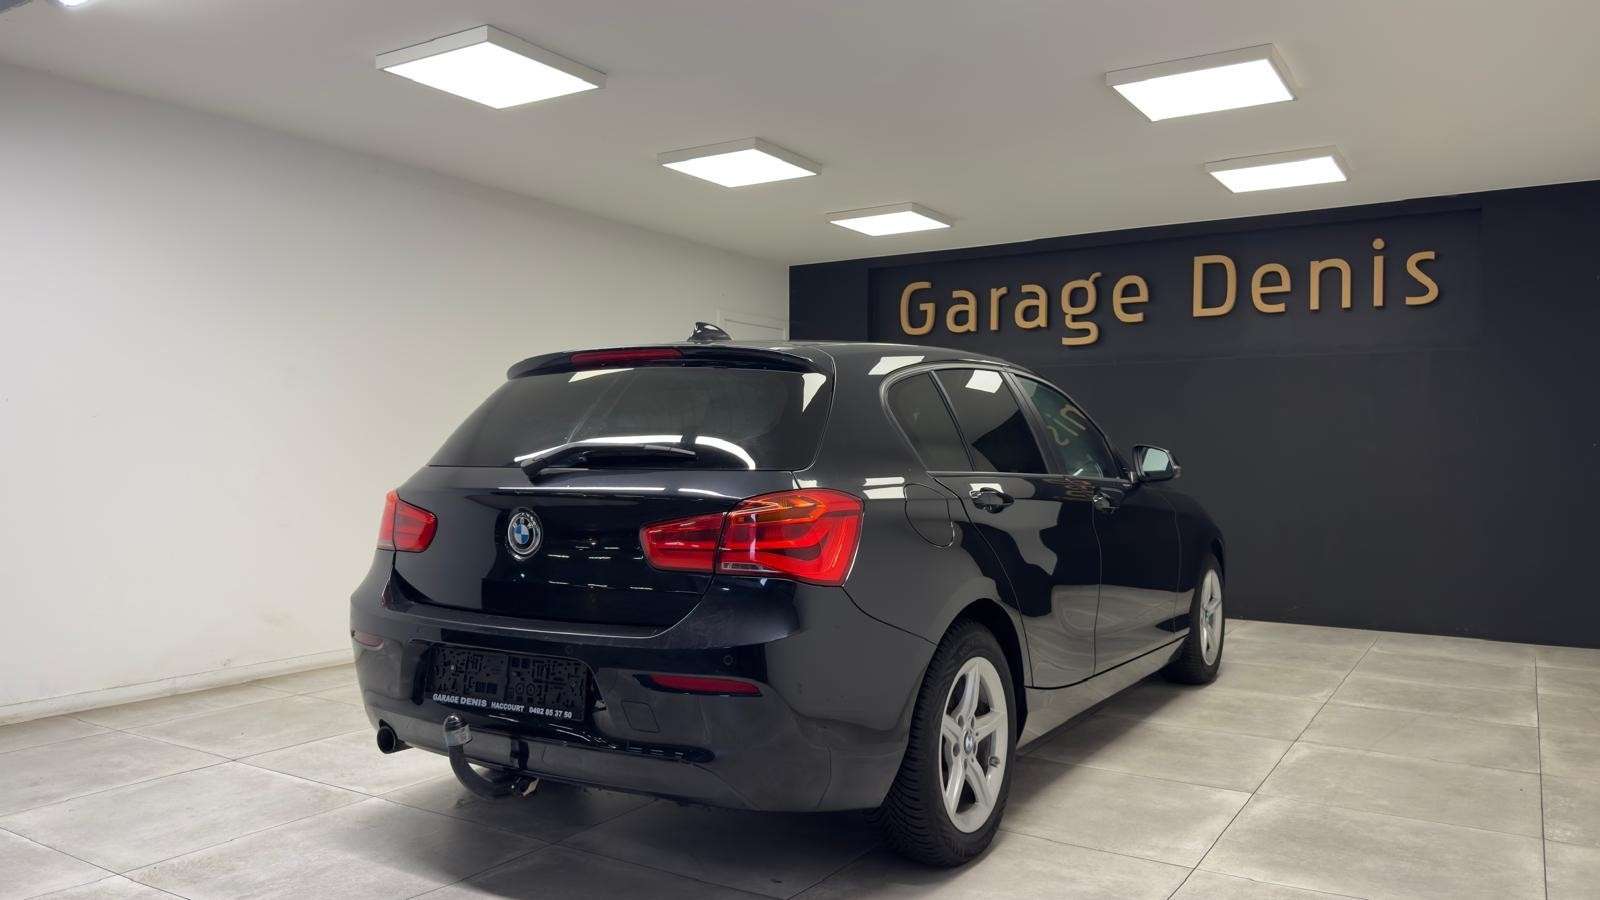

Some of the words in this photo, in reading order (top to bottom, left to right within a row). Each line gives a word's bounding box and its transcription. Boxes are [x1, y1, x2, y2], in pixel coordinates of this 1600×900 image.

[900, 271, 1149, 346] Garage
[1192, 238, 1439, 318] Denis
[432, 693, 460, 704] GARAGE
[460, 696, 487, 708] DENIS
[490, 701, 525, 713] HACCOURT
